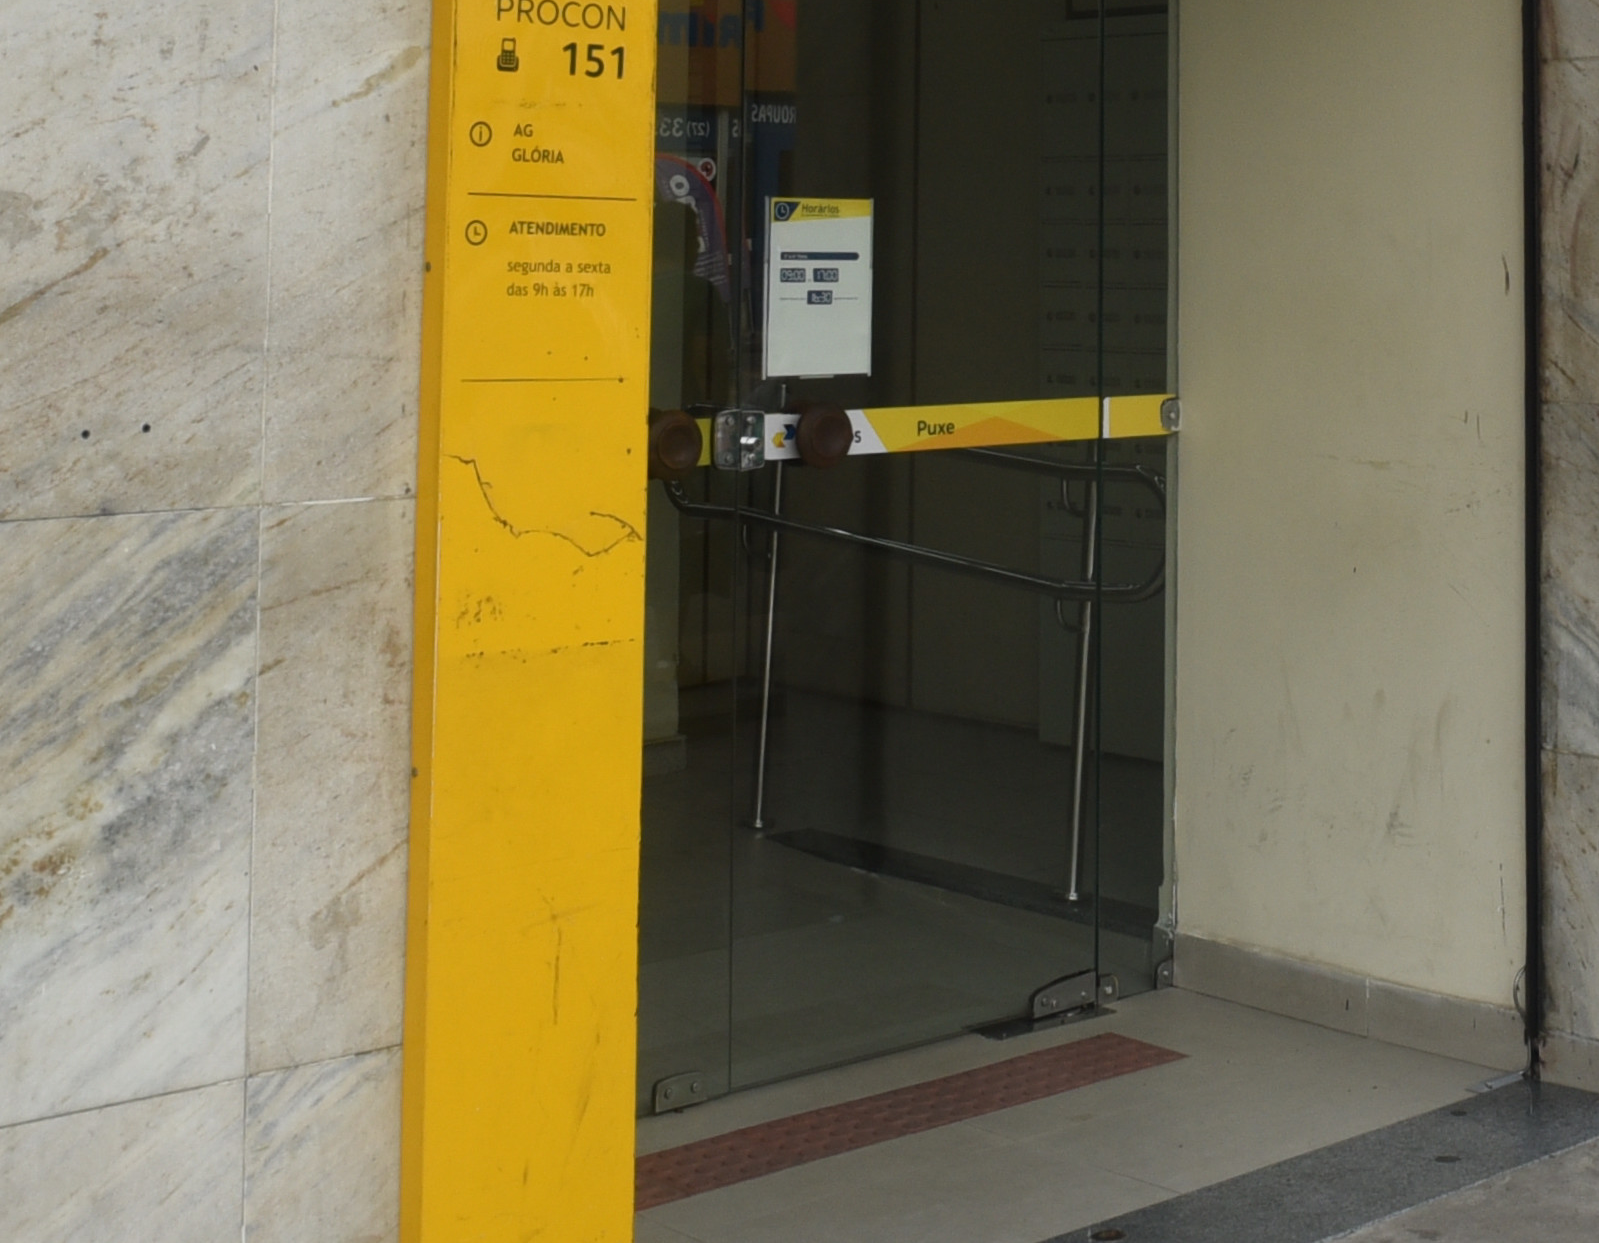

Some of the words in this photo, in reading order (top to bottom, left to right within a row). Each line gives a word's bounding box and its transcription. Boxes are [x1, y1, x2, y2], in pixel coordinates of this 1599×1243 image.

[562, 42, 625, 79] 151
[513, 123, 533, 138] AG
[511, 146, 565, 164] GLÓRIA
[509, 220, 606, 237] ATENDIMENTO
[507, 259, 561, 276] segunda
[565, 262, 573, 273] a
[577, 262, 611, 274] sexta
[506, 283, 529, 297] das
[532, 282, 549, 297] 9h
[552, 281, 567, 297] às
[571, 283, 595, 298] 17h
[916, 419, 956, 437] Puxe
